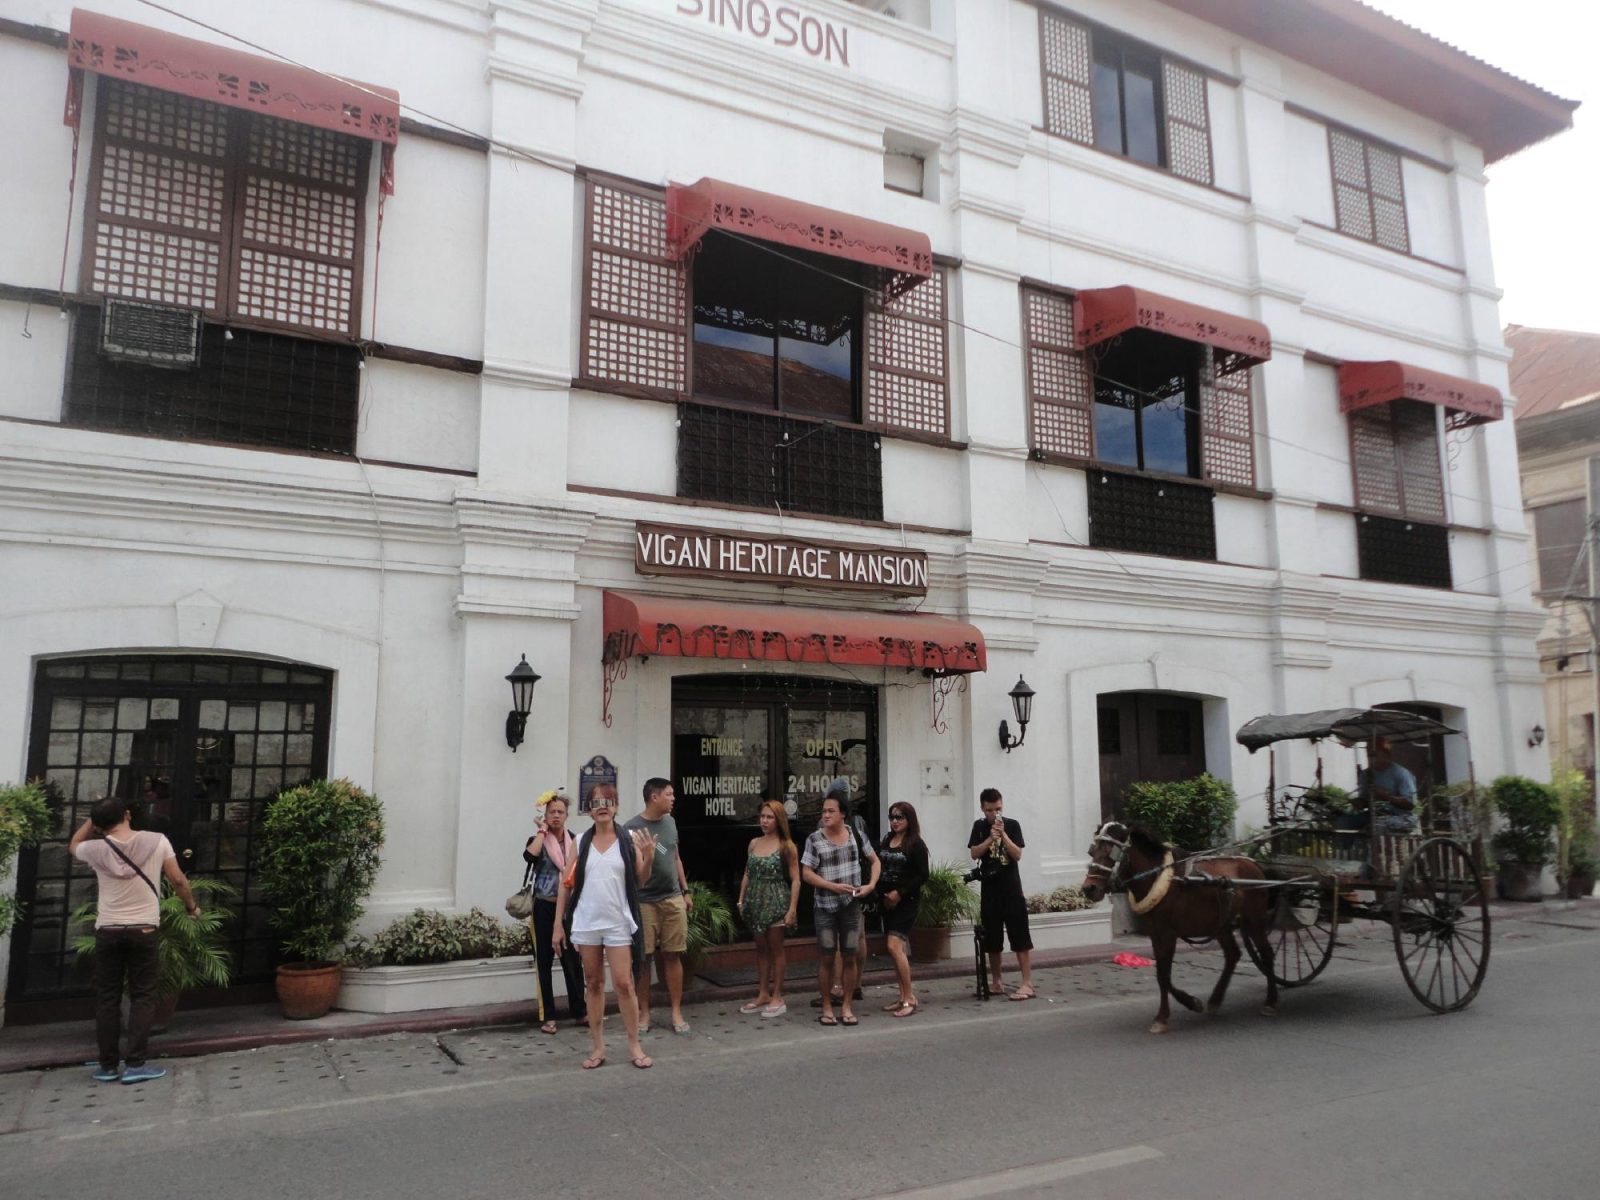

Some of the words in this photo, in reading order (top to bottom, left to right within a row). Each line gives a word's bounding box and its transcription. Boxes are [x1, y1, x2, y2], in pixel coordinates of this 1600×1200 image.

[637, 532, 711, 568] VIGAN
[719, 540, 832, 579] HERITAGE
[838, 551, 928, 588] MANSION
[701, 738, 743, 756] ENTRANCE
[806, 739, 842, 756] OPEN
[682, 776, 712, 795] VIGAN
[715, 776, 761, 794] HERITAGE
[788, 775, 806, 793] 24
[810, 775, 859, 793] HOS
[705, 797, 736, 816] HOTEL
